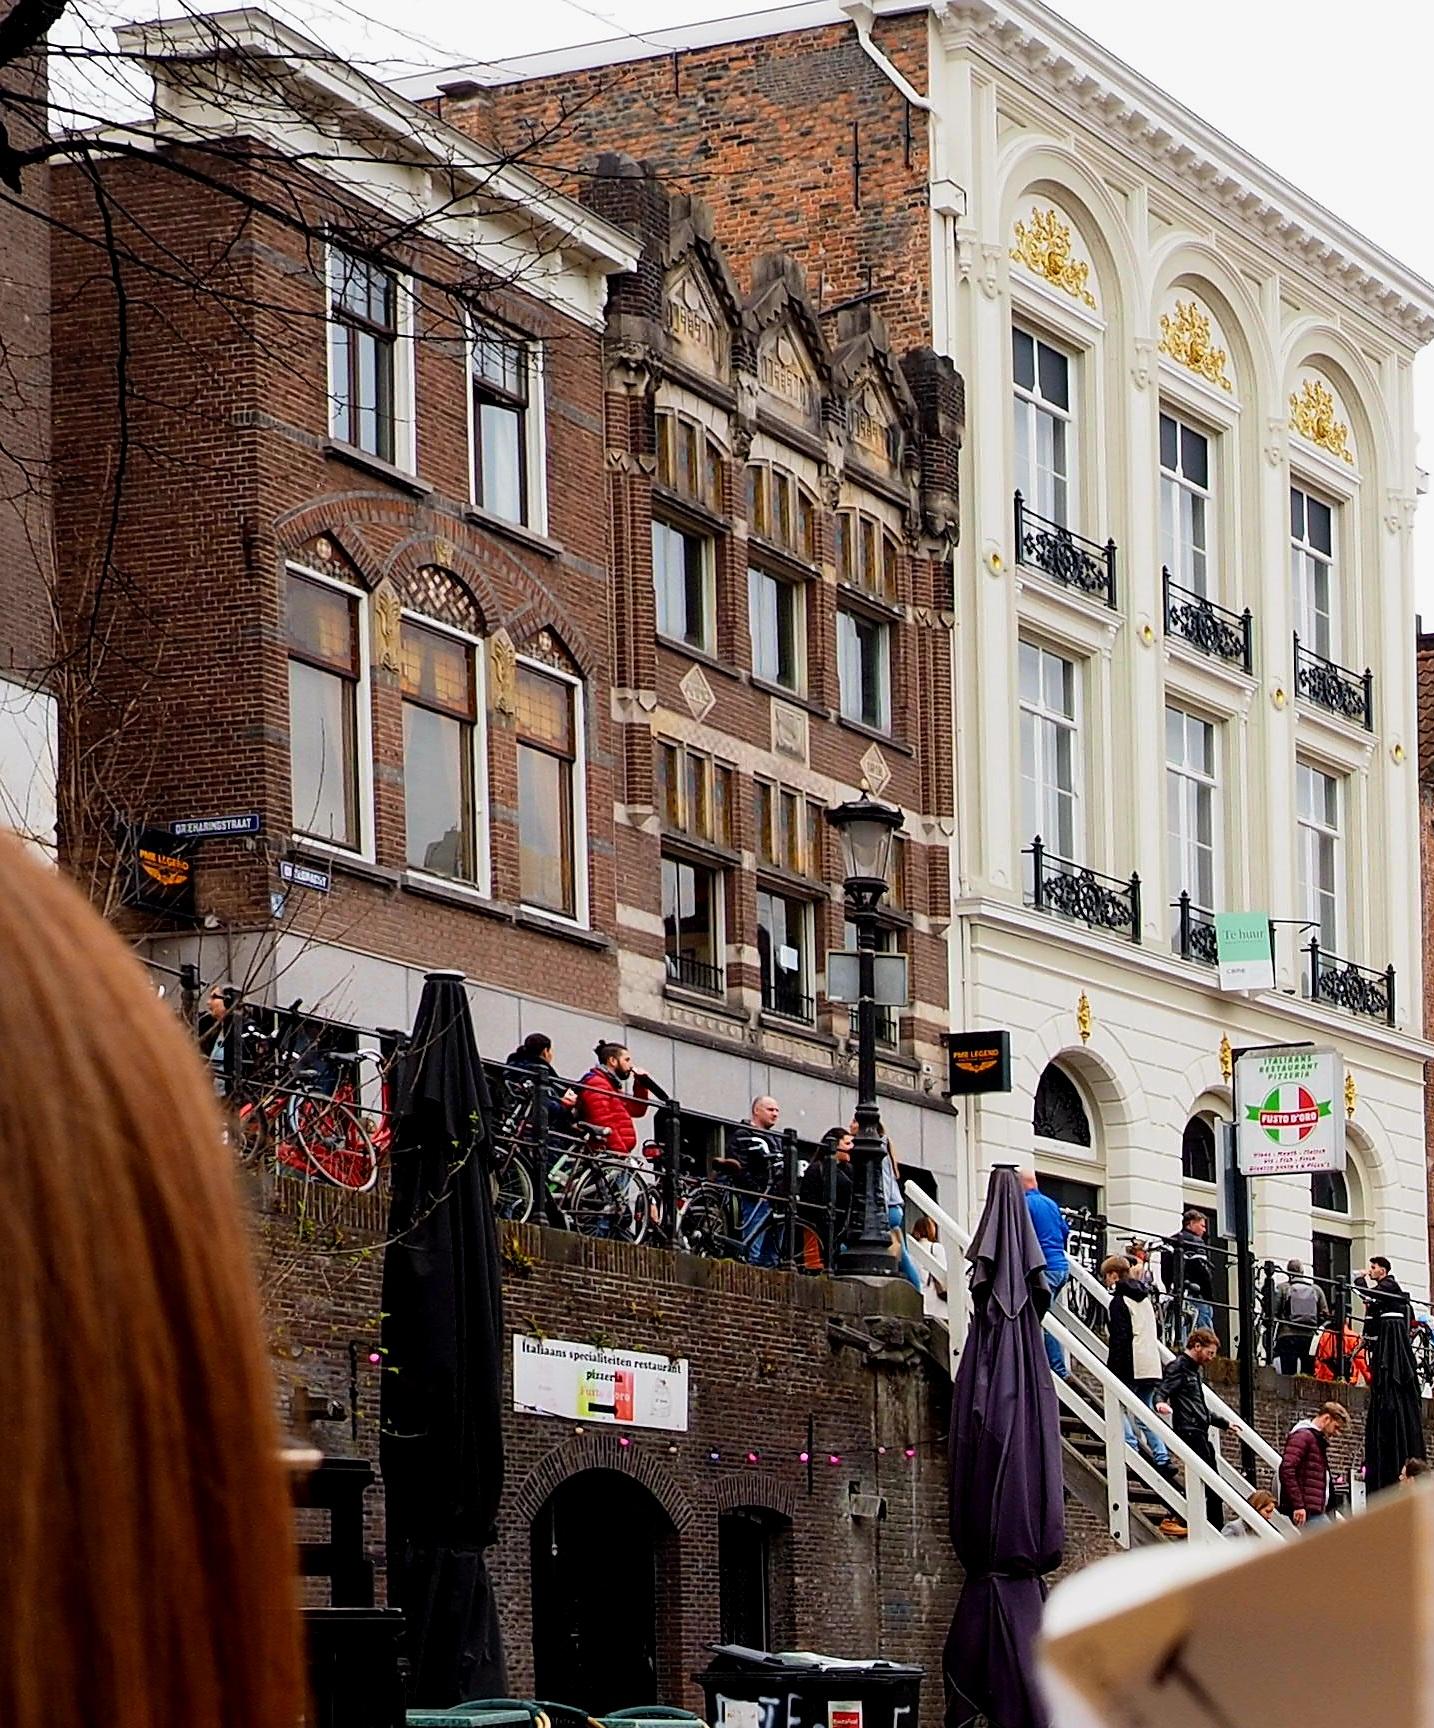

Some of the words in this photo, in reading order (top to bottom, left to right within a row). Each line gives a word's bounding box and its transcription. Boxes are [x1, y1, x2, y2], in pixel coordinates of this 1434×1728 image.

[1224, 929, 1237, 940] Te
[1239, 928, 1265, 940] huur
[970, 1048, 999, 1057] LEGEND
[1259, 1062, 1318, 1073] RESTAURANT
[1267, 1071, 1310, 1080] PIZZERIA
[1261, 1113, 1290, 1124] FUSTO
[1290, 1112, 1317, 1122] D'ORO
[521, 1339, 567, 1359] Italiaans
[569, 1350, 632, 1367] specialiteiten
[634, 1359, 682, 1374] restaurant
